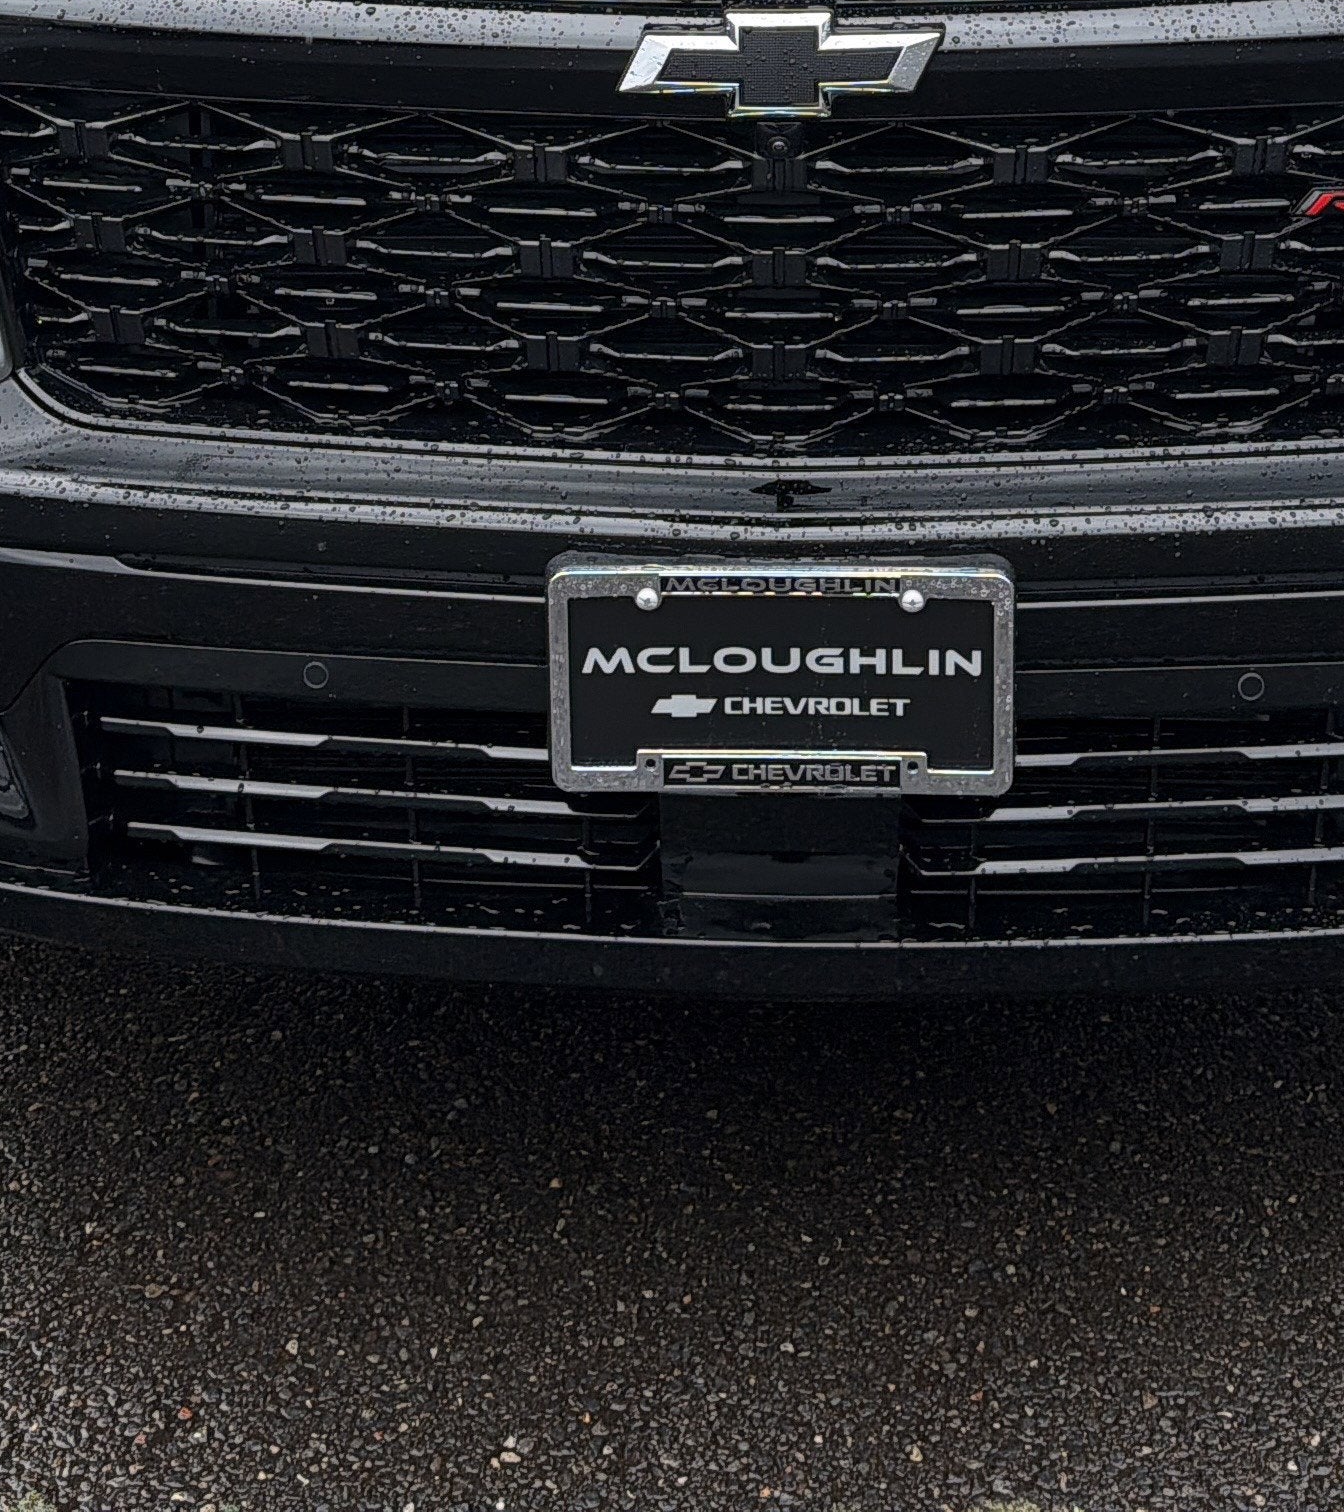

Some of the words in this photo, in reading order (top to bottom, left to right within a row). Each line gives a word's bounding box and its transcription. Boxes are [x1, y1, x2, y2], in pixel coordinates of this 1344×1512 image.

[664, 577, 898, 593] MCLOUGHLIN
[581, 646, 982, 677] MCLOUGHLIN
[724, 696, 911, 717] CHEVROLET
[731, 762, 897, 784] CHEVROLET
